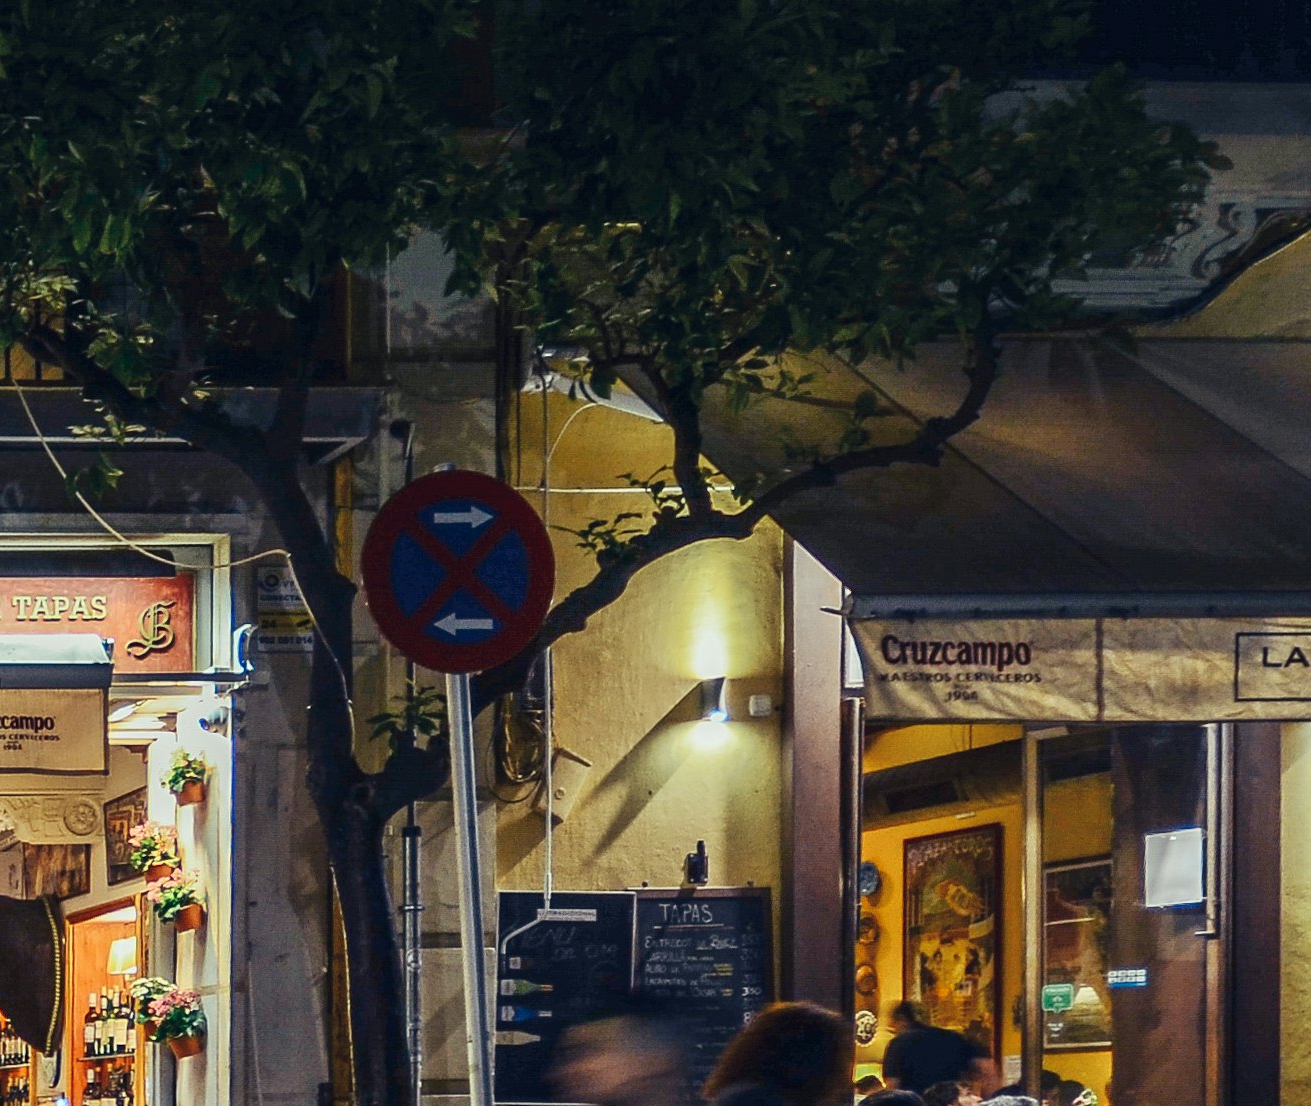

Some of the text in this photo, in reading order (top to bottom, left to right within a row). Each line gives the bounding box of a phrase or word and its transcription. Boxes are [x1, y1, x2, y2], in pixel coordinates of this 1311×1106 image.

[11, 596, 107, 622] TAPAS
[881, 634, 1031, 672] Cruzcampo
[659, 903, 713, 923] TAPAS
